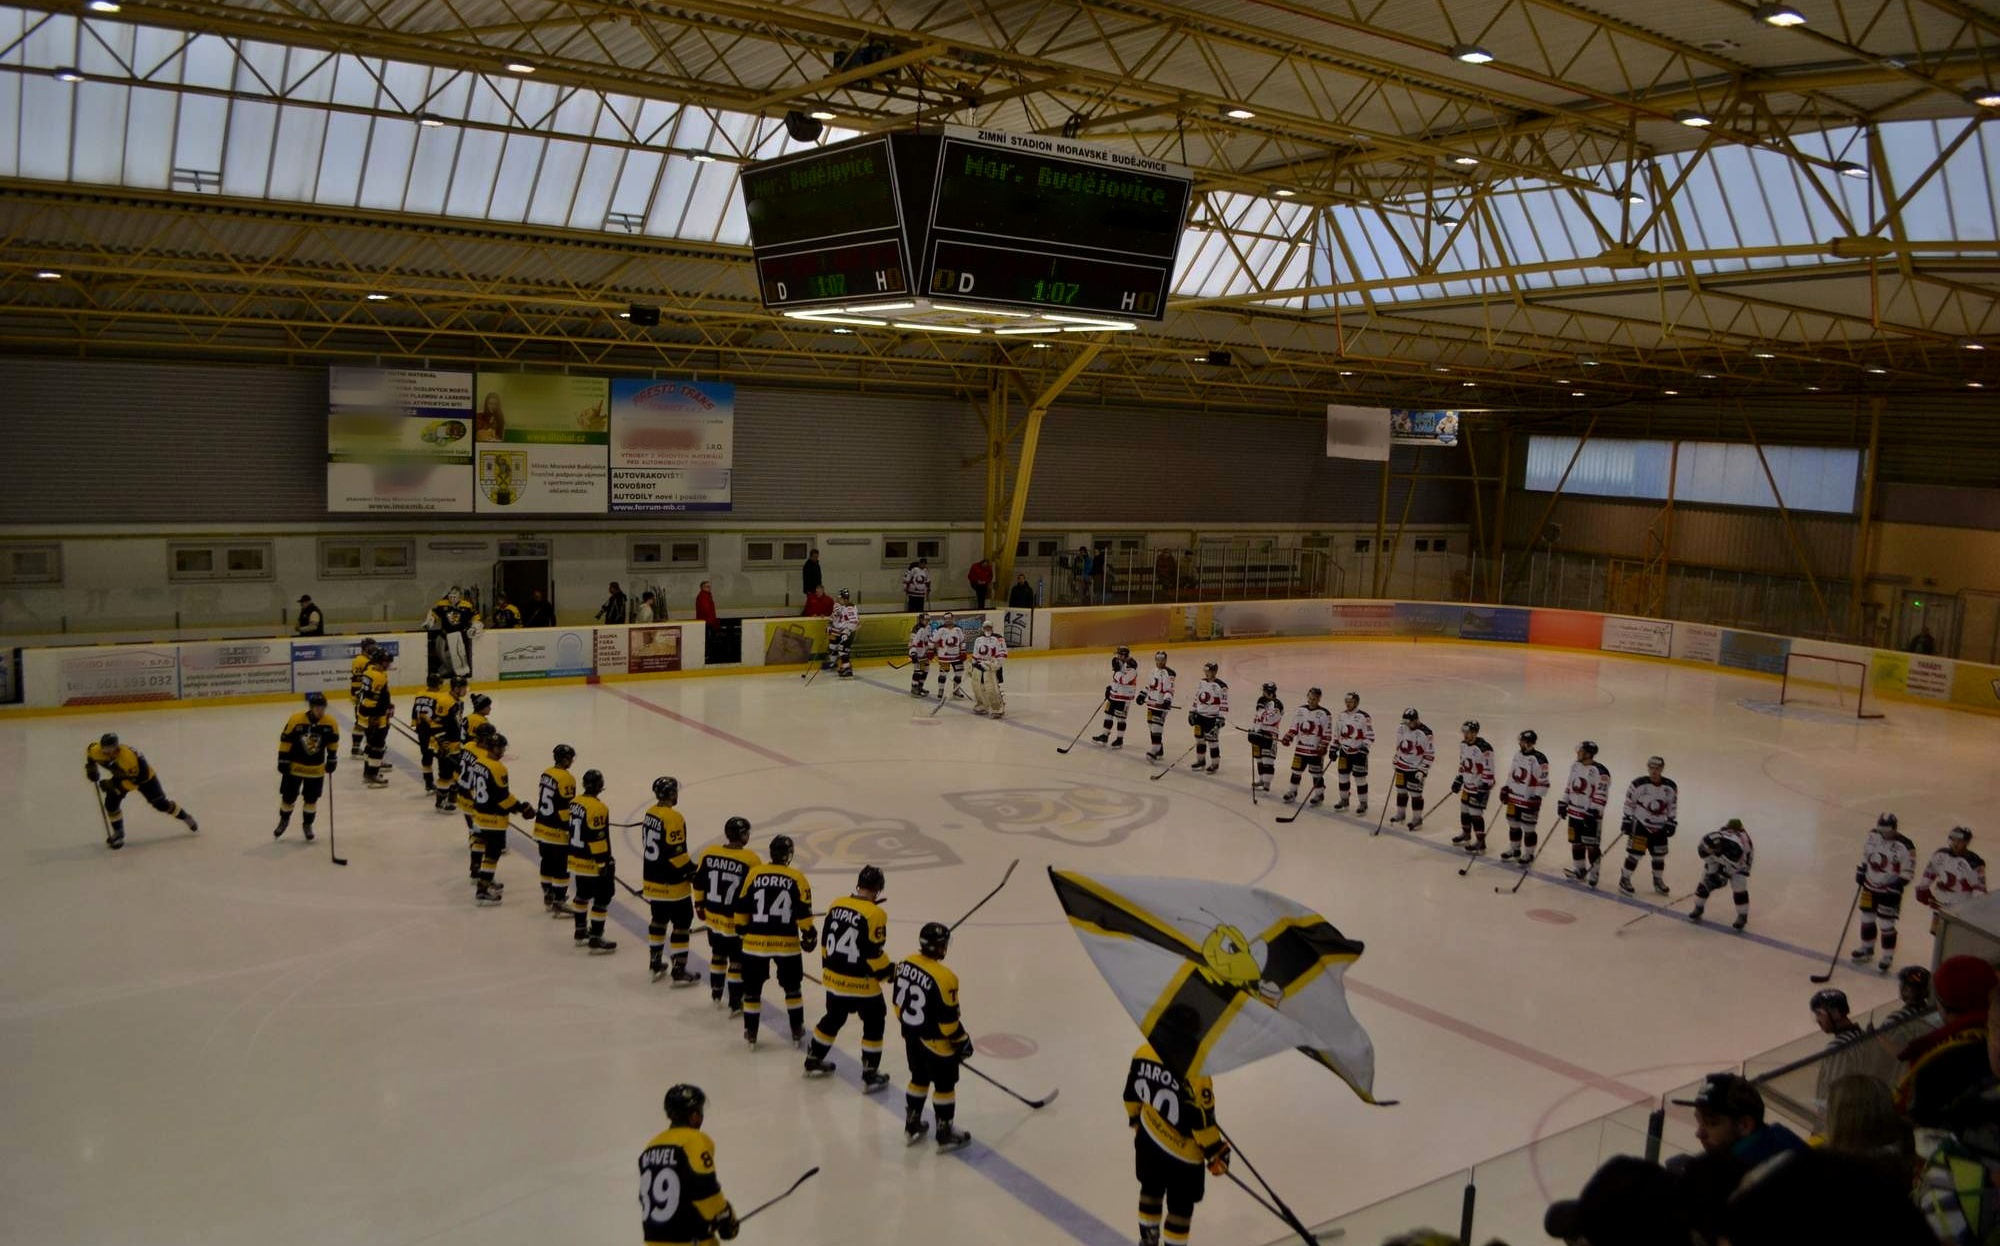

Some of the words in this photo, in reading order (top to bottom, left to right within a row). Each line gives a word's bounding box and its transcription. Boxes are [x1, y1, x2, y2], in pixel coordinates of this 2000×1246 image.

[978, 130, 1007, 144] ZIMNÍ
[1011, 136, 1053, 152] STADION
[1057, 144, 1108, 161] MORAVSKÉ
[1112, 154, 1167, 172] BUDĚJOVICE
[777, 282, 788, 300] D
[875, 270, 888, 291] H
[958, 272, 975, 293] D
[1033, 279, 1079, 304] 1:07
[1121, 291, 1136, 311] H
[150, 675, 172, 686] 032
[706, 869, 741, 906] 17
[752, 888, 793, 925] 14
[895, 976, 927, 1026] 73
